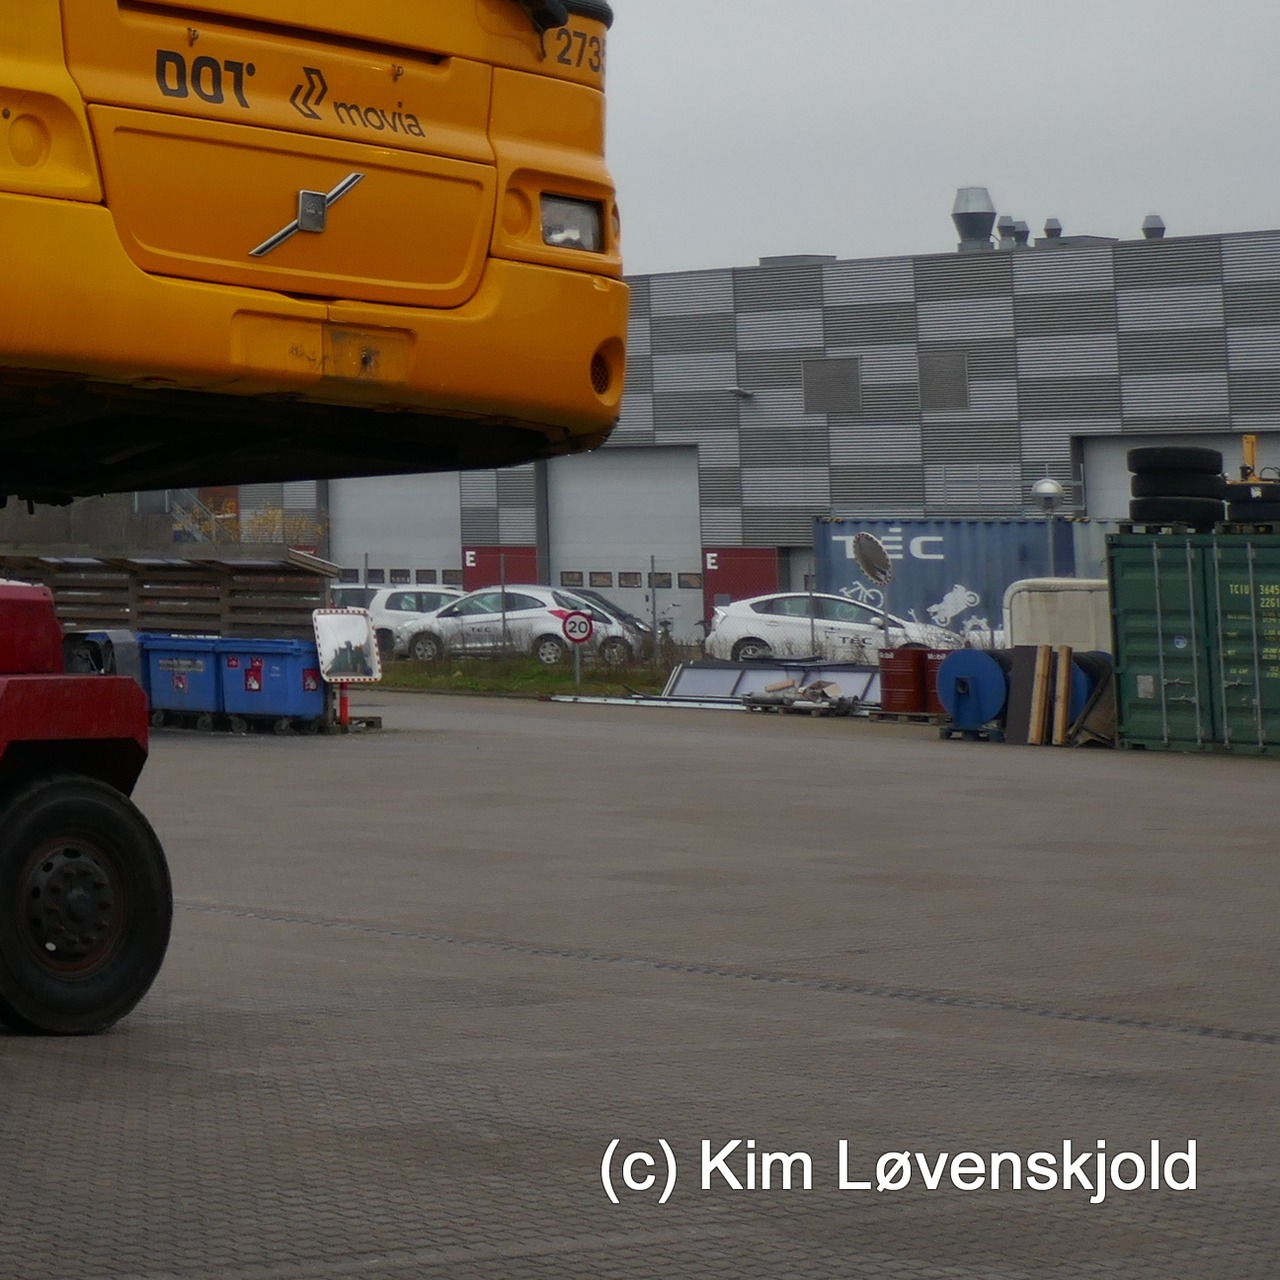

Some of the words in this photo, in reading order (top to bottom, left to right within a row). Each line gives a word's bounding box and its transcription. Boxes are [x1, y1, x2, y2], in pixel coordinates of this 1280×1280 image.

[333, 101, 427, 139] movia
[465, 551, 476, 567] E
[706, 553, 718, 570] E
[568, 620, 588, 635] 20
